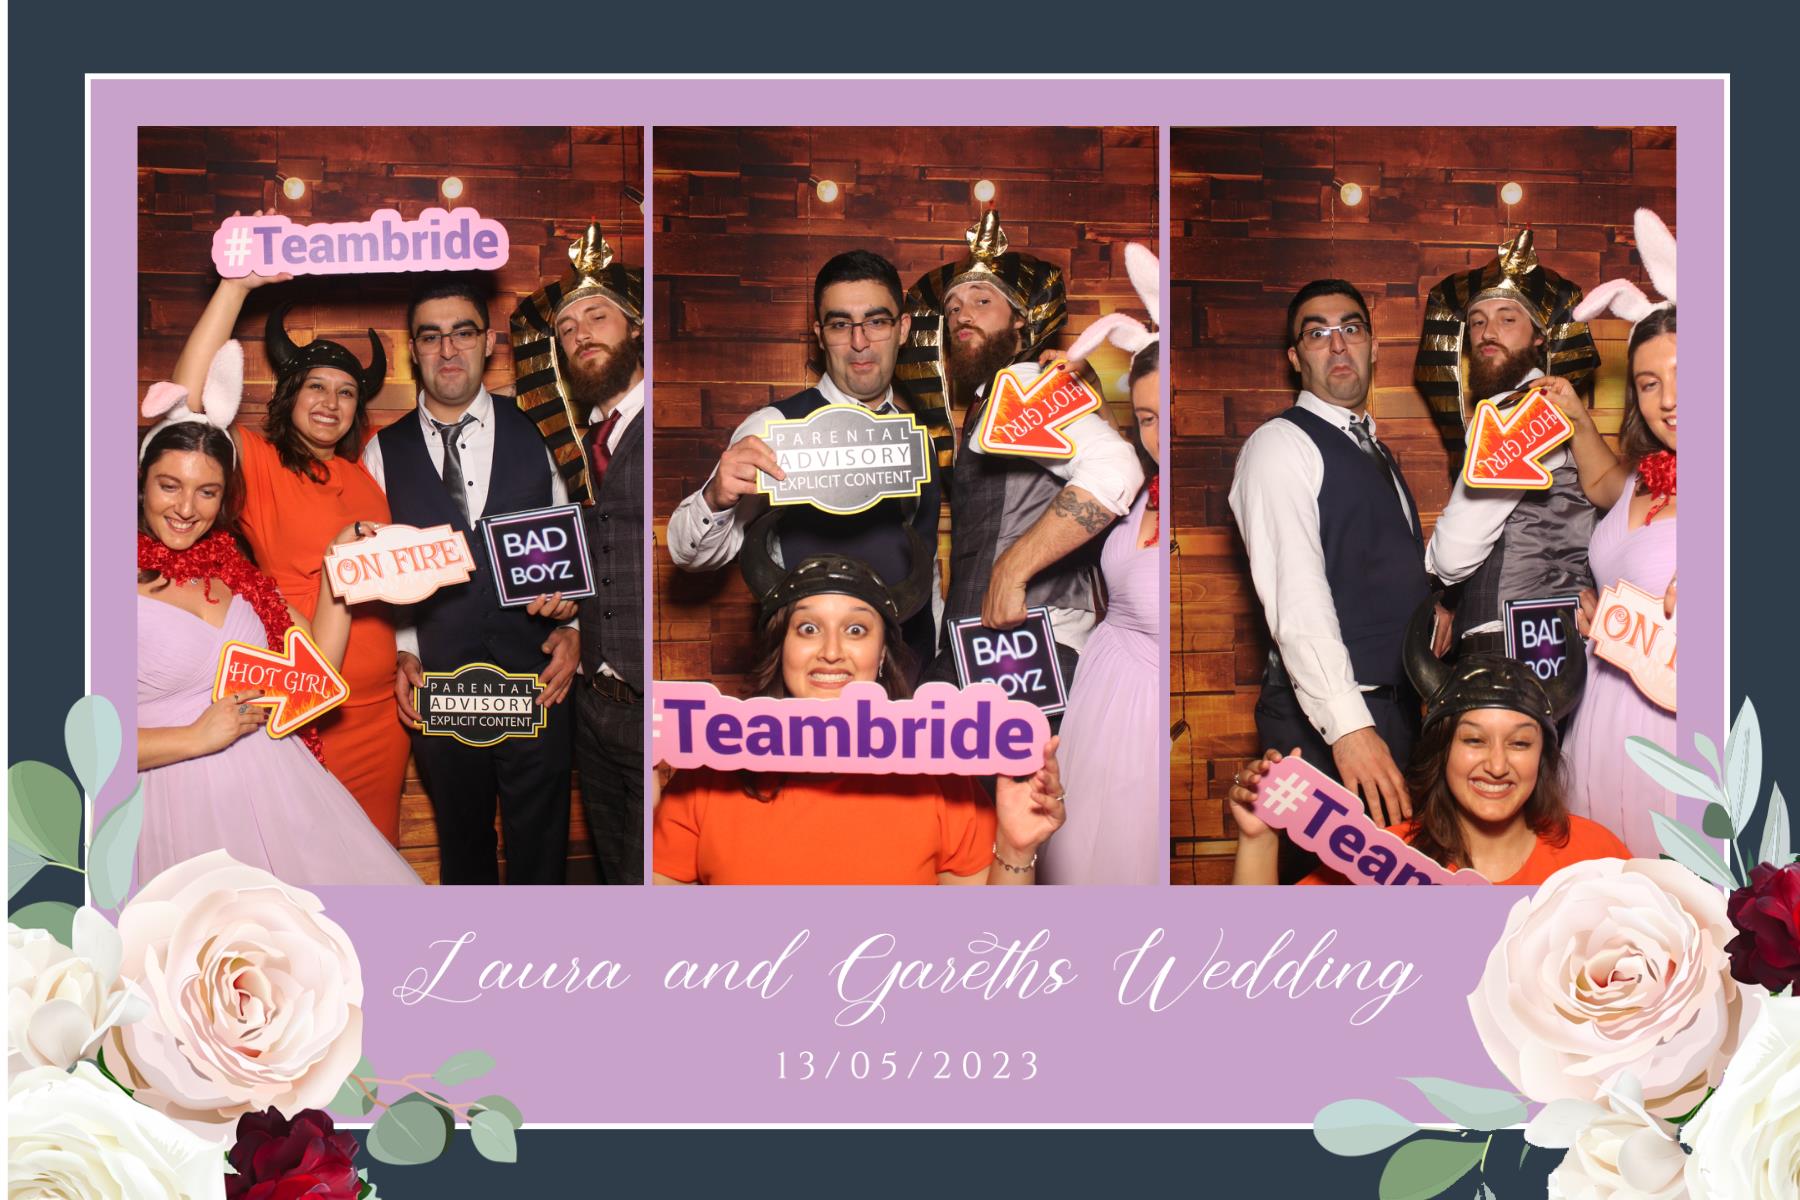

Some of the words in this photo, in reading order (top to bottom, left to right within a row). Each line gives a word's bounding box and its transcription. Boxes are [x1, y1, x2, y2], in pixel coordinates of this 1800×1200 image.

[223, 217, 500, 268] #Teambride
[1042, 382, 1084, 418] HOT
[776, 428, 910, 447] PARENTAL
[994, 408, 1044, 443] GIRL
[1520, 409, 1559, 449] HOT
[780, 446, 911, 470] ADVISORY
[1477, 439, 1522, 477] GIRL
[780, 474, 841, 492] EXPLICIT
[844, 470, 912, 487] CONTENT
[503, 527, 568, 557] BAD
[336, 552, 385, 585] ON
[389, 539, 464, 575] FIRE
[511, 560, 574, 585] BOYZ
[1603, 604, 1664, 657] ON
[972, 630, 1038, 666] BAD
[229, 661, 283, 688] HOT
[284, 670, 333, 699] GIRL
[430, 682, 532, 694] PARENTAL
[981, 668, 1047, 696] OYZ
[431, 697, 533, 711] ADVISORY
[430, 715, 477, 726] EXPLICIT
[480, 716, 532, 727] CONTENT
